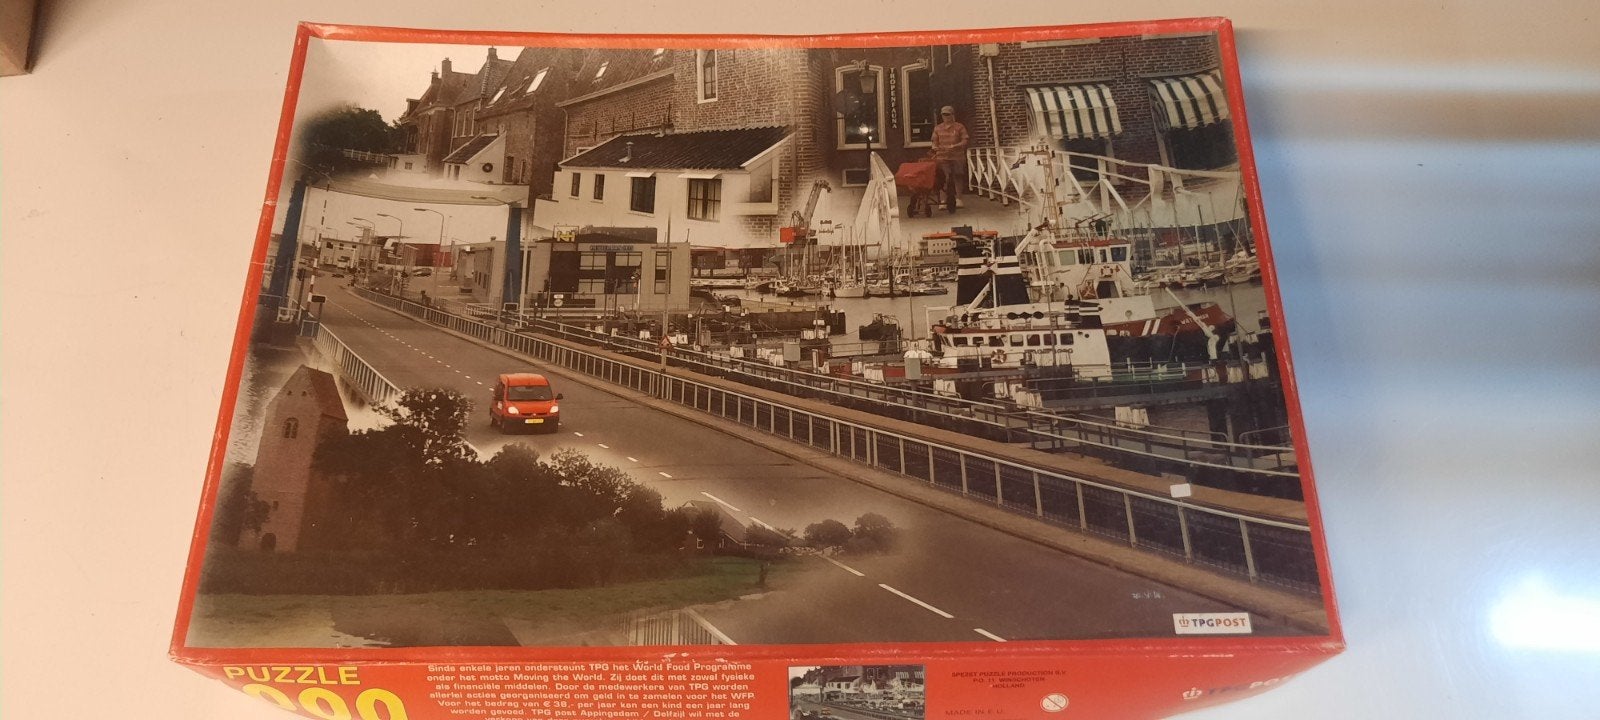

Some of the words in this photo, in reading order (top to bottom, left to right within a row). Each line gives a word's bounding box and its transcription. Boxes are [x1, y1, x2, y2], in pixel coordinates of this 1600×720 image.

[1191, 618, 1246, 627] TPGPOST
[589, 663, 609, 671] TPG
[667, 663, 690, 671] Food
[694, 663, 752, 672] Programme
[223, 666, 360, 685] PUZZLE
[513, 674, 548, 682] Moving
[553, 673, 569, 681] the
[572, 673, 605, 681] World.
[610, 673, 622, 682] Zij
[691, 673, 718, 681] zowel
[722, 673, 755, 682] fysieke
[599, 683, 665, 691] medewerkers
[430, 691, 463, 699] allerlei
[500, 692, 570, 700] georganiseerd
[707, 702, 725, 710] jaar
[730, 702, 750, 710] lang
